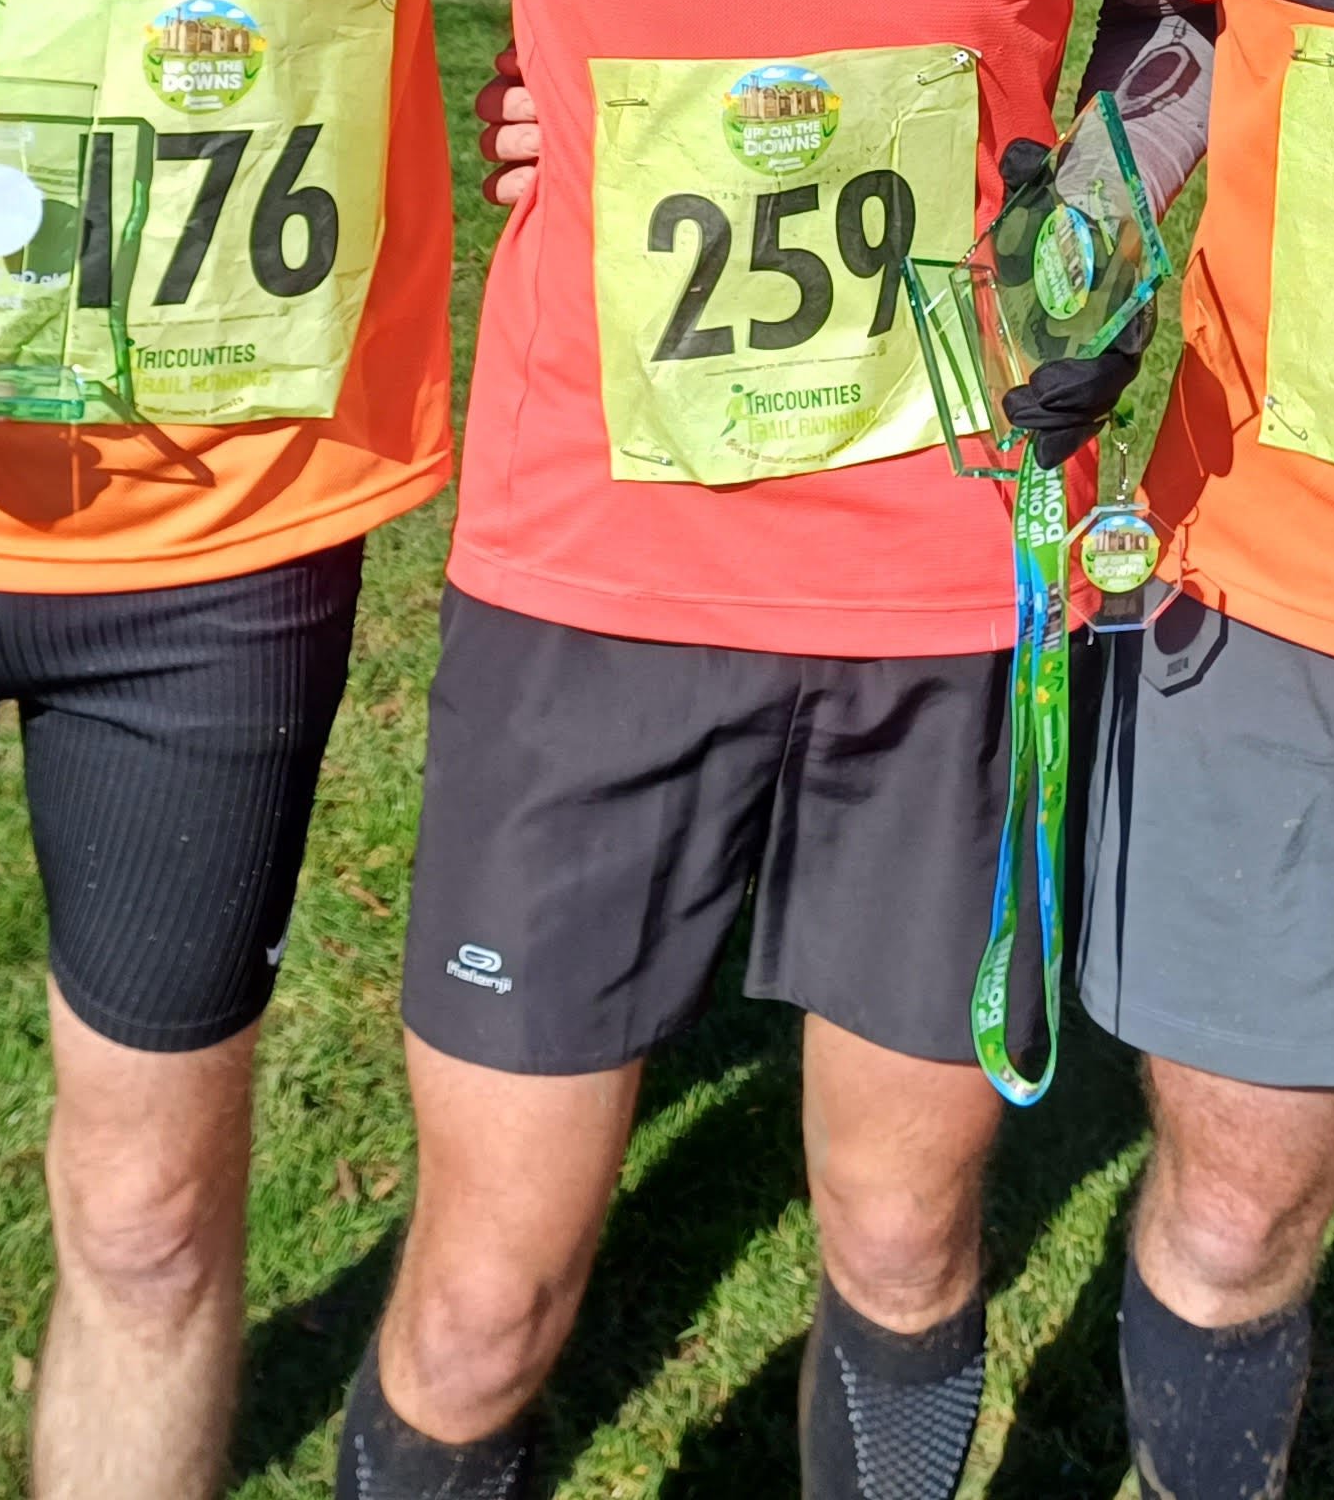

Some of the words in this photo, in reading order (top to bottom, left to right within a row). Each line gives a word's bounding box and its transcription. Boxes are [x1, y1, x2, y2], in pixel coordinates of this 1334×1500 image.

[215, 59, 243, 72] THE
[161, 73, 242, 92] DOWNS
[743, 127, 765, 140] UP
[770, 125, 793, 138] ON
[794, 120, 821, 135] THE
[743, 134, 822, 156] DOWNS
[78, 123, 339, 309] 176
[647, 169, 916, 362] 259
[135, 343, 256, 369] TRICOUNTIES
[746, 383, 861, 415] TRICOUNTIES
[1028, 485, 1044, 517] ON
[1029, 520, 1045, 548] UP
